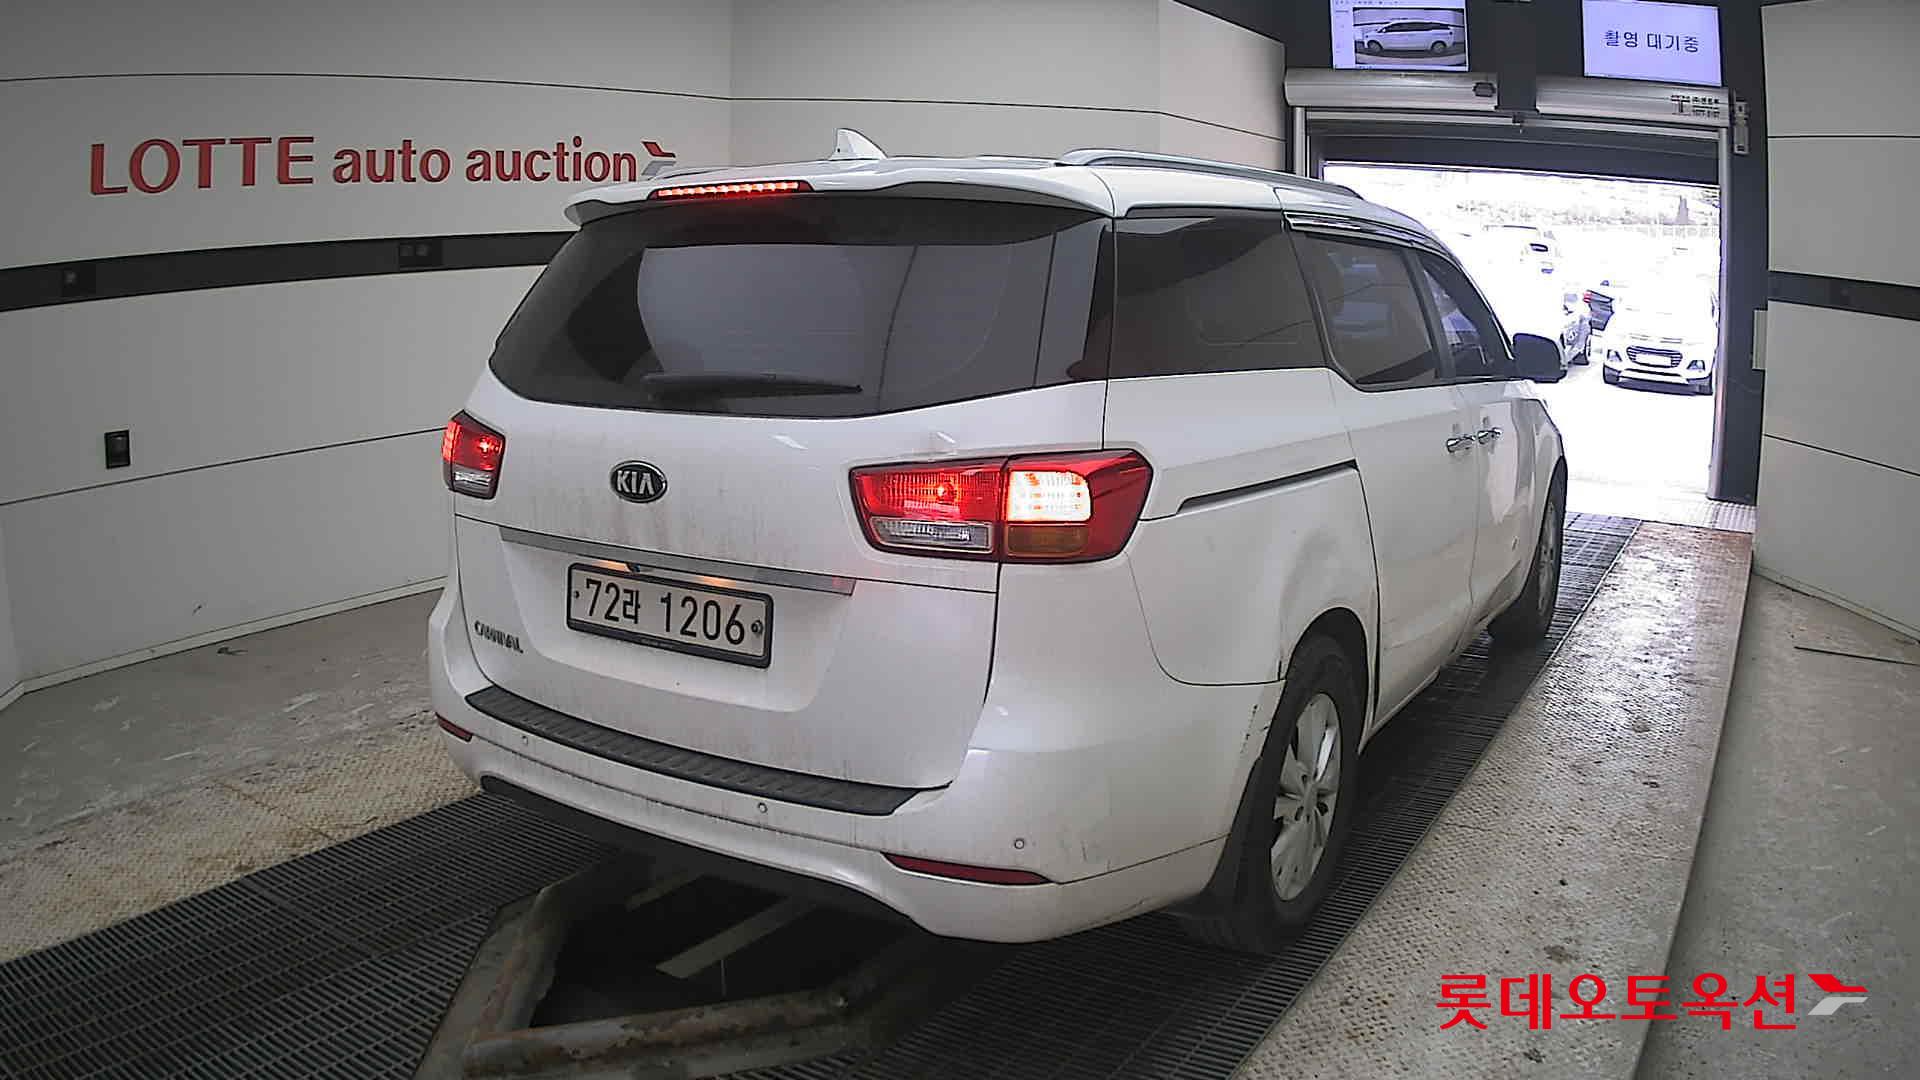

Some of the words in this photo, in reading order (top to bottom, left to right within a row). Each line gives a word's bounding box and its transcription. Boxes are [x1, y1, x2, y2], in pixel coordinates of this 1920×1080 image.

[1604, 30, 1638, 49] 촬영
[1646, 33, 1699, 53] 대기중
[90, 136, 314, 195] LOTTE
[332, 139, 450, 184] auto
[465, 136, 637, 183] auction
[617, 470, 655, 495] KIA
[585, 578, 641, 625] 72라
[660, 591, 745, 645] 1206
